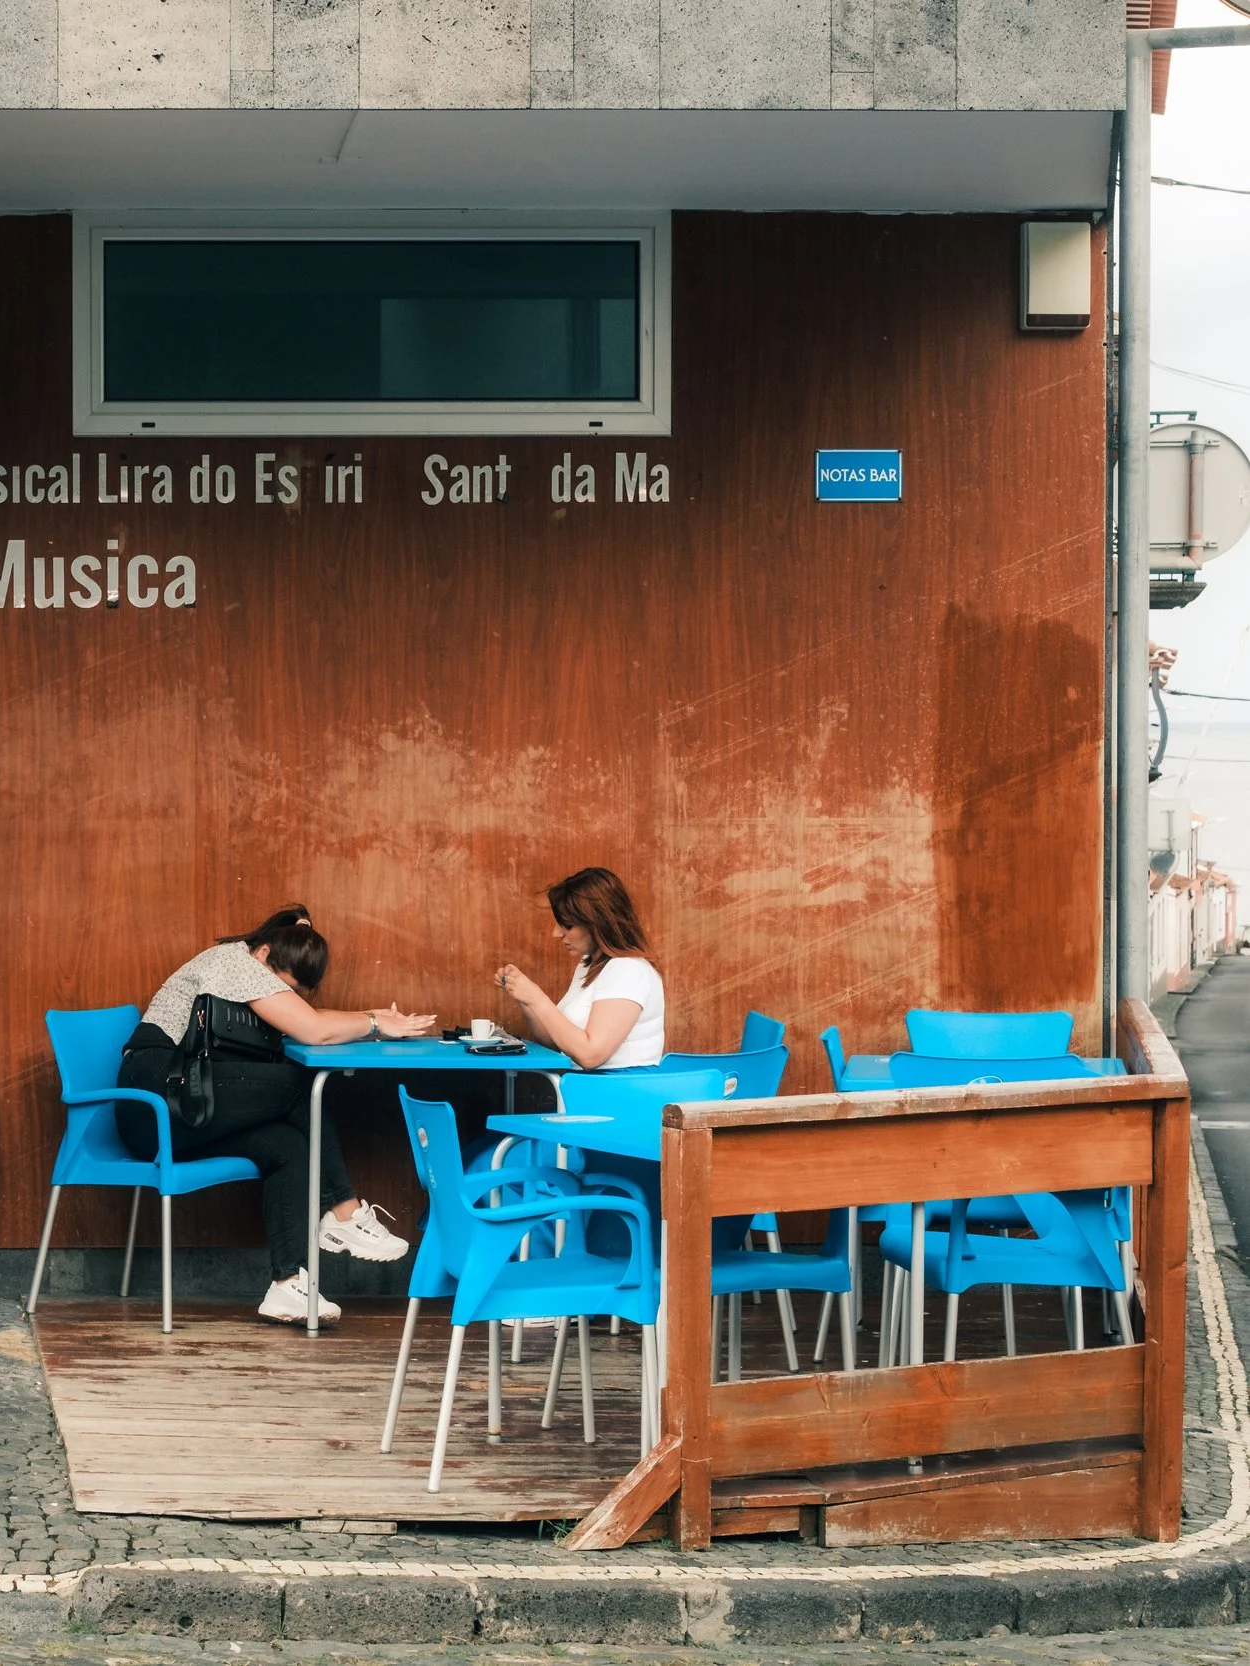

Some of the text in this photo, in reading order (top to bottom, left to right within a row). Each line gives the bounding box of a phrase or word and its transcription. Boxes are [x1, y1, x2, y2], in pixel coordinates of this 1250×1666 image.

[97, 452, 173, 504] Lira
[189, 454, 236, 504] do
[551, 452, 596, 503] da
[820, 468, 897, 482] NOTAS BAR
